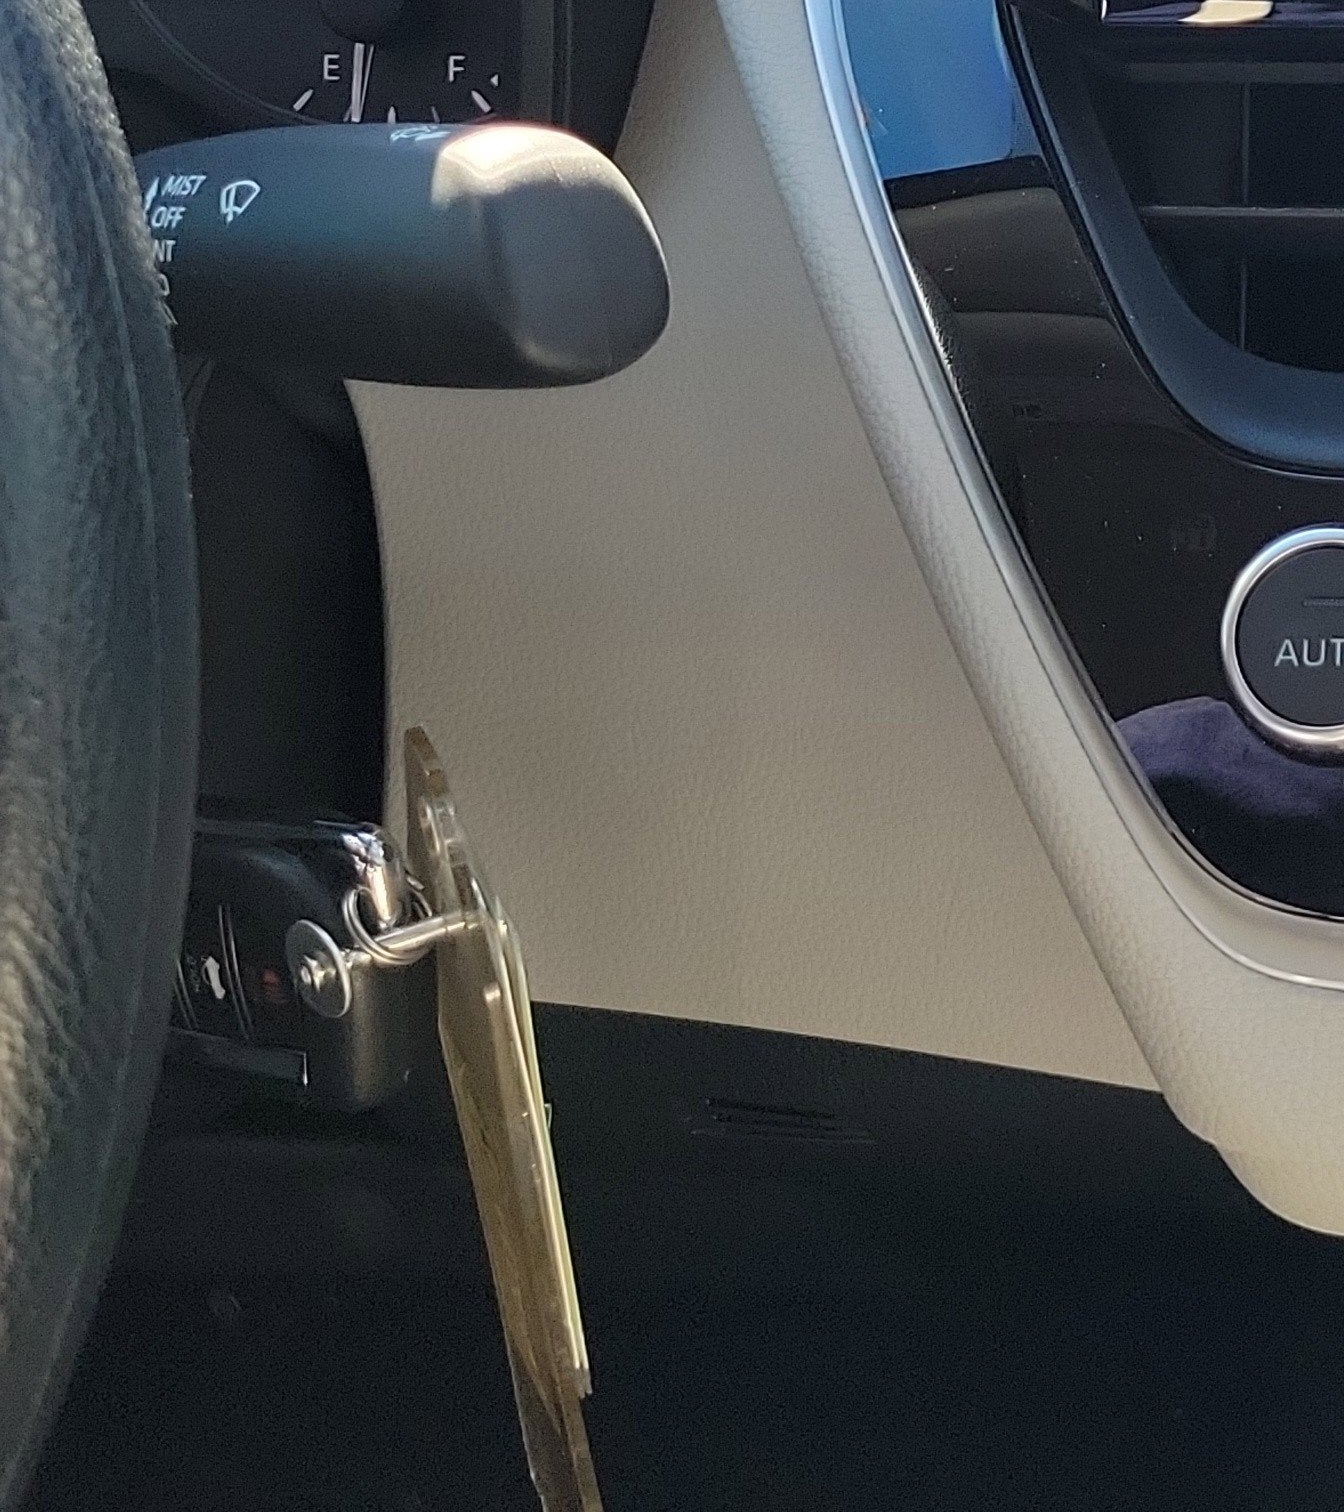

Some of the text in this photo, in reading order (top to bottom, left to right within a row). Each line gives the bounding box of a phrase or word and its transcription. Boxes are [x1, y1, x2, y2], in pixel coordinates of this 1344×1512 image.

[323, 54, 339, 81] E
[448, 55, 465, 82] F
[162, 175, 206, 196] MIST
[151, 206, 185, 228] OFF
[153, 240, 175, 261] NT
